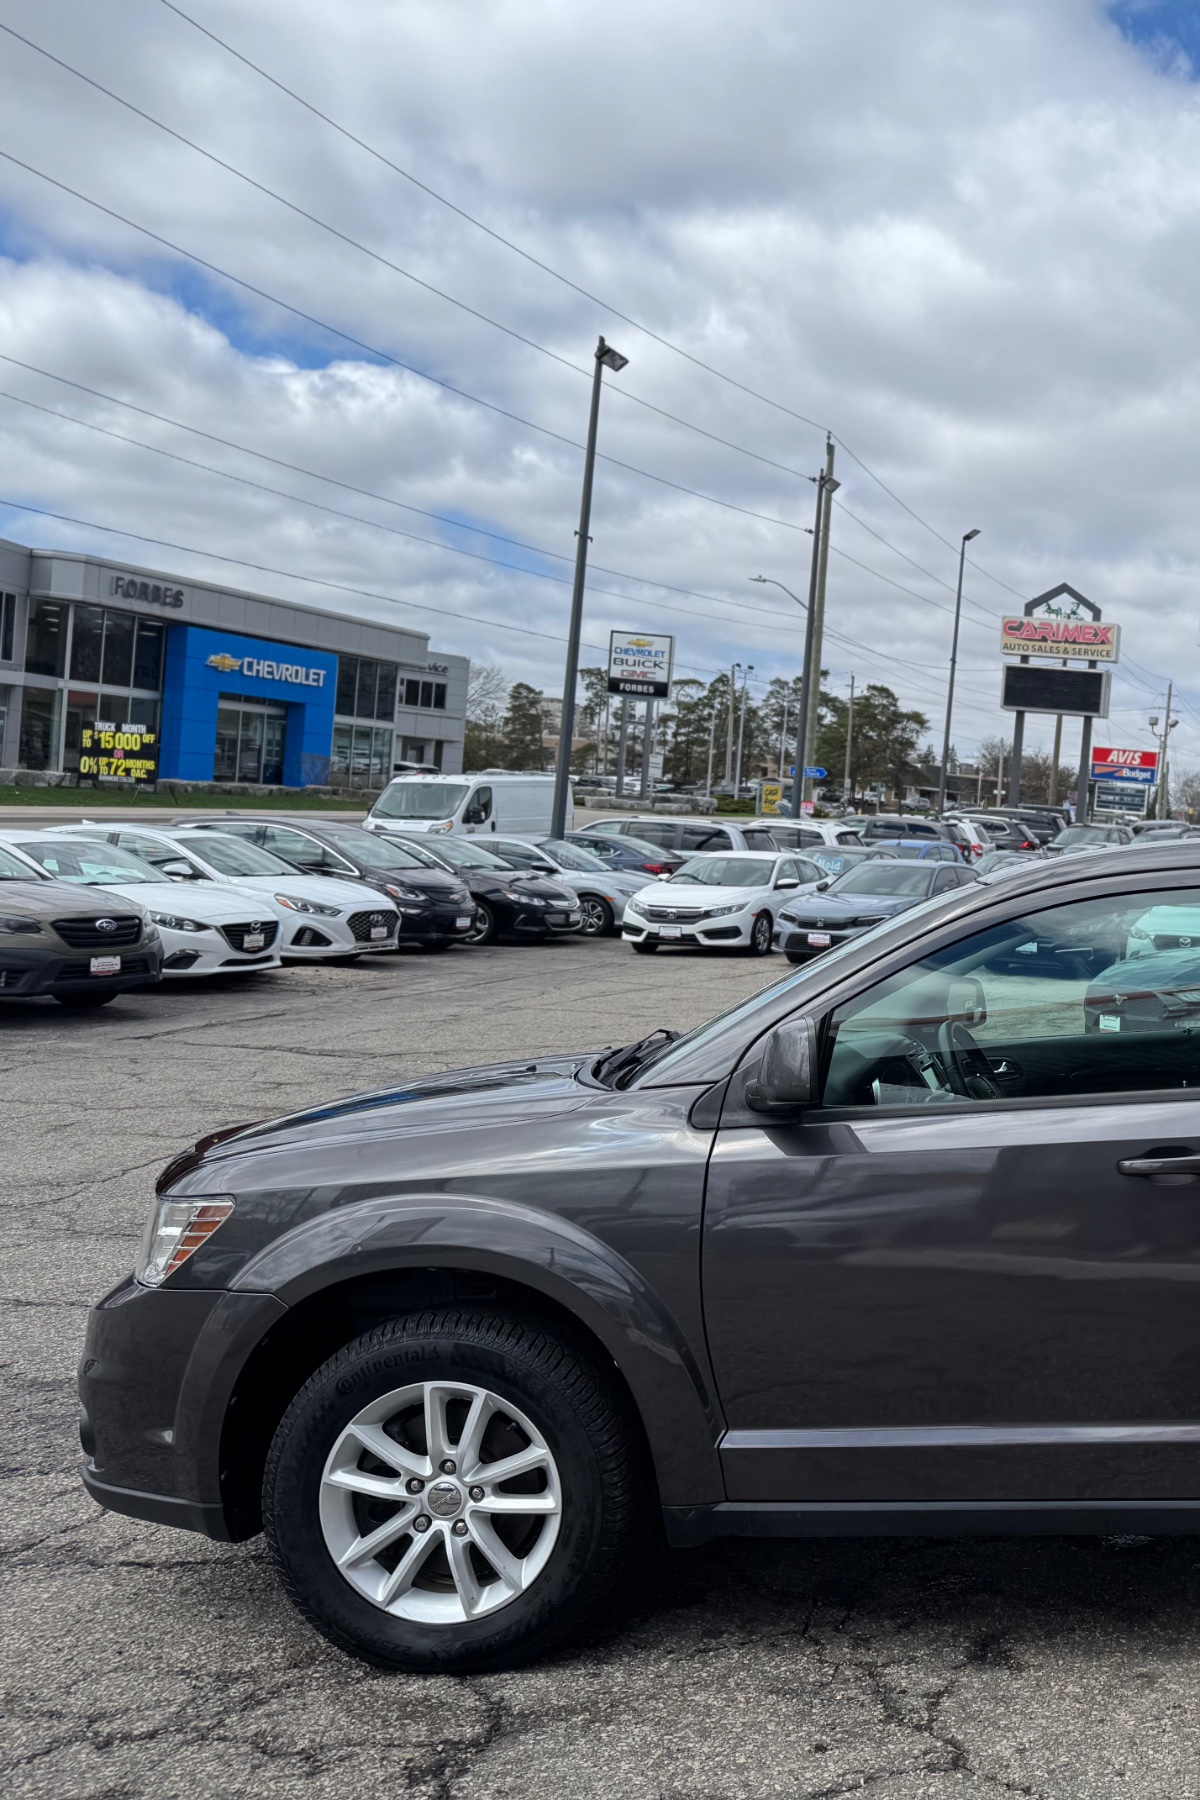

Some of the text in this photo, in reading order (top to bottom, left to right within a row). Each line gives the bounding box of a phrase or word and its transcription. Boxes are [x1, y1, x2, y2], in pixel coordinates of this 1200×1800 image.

[111, 576, 184, 608] FORBES
[1003, 620, 1112, 644] CARIMEX
[614, 647, 665, 658] CHEVROLET
[1003, 643, 1029, 652] AUTO
[1031, 645, 1060, 654] SALES
[1072, 648, 1111, 657] SERVICE
[613, 657, 665, 670] BUICK
[243, 657, 326, 687] CHEVROLET
[621, 669, 656, 679] GMC
[620, 683, 654, 693] FORBES
[94, 722, 146, 734] TRUCK MONTH
[82, 729, 92, 739] UP
[142, 734, 155, 743] OFF
[82, 739, 91, 748] TO
[114, 750, 124, 758] OR
[1107, 750, 1142, 765] AVIS
[80, 756, 155, 776] 0% UP 72 MONTHS
[100, 766, 108, 775] TO
[1123, 768, 1151, 780] Budget
[818, 858, 840, 870] Hold
[334, 1346, 426, 1395] Continental
